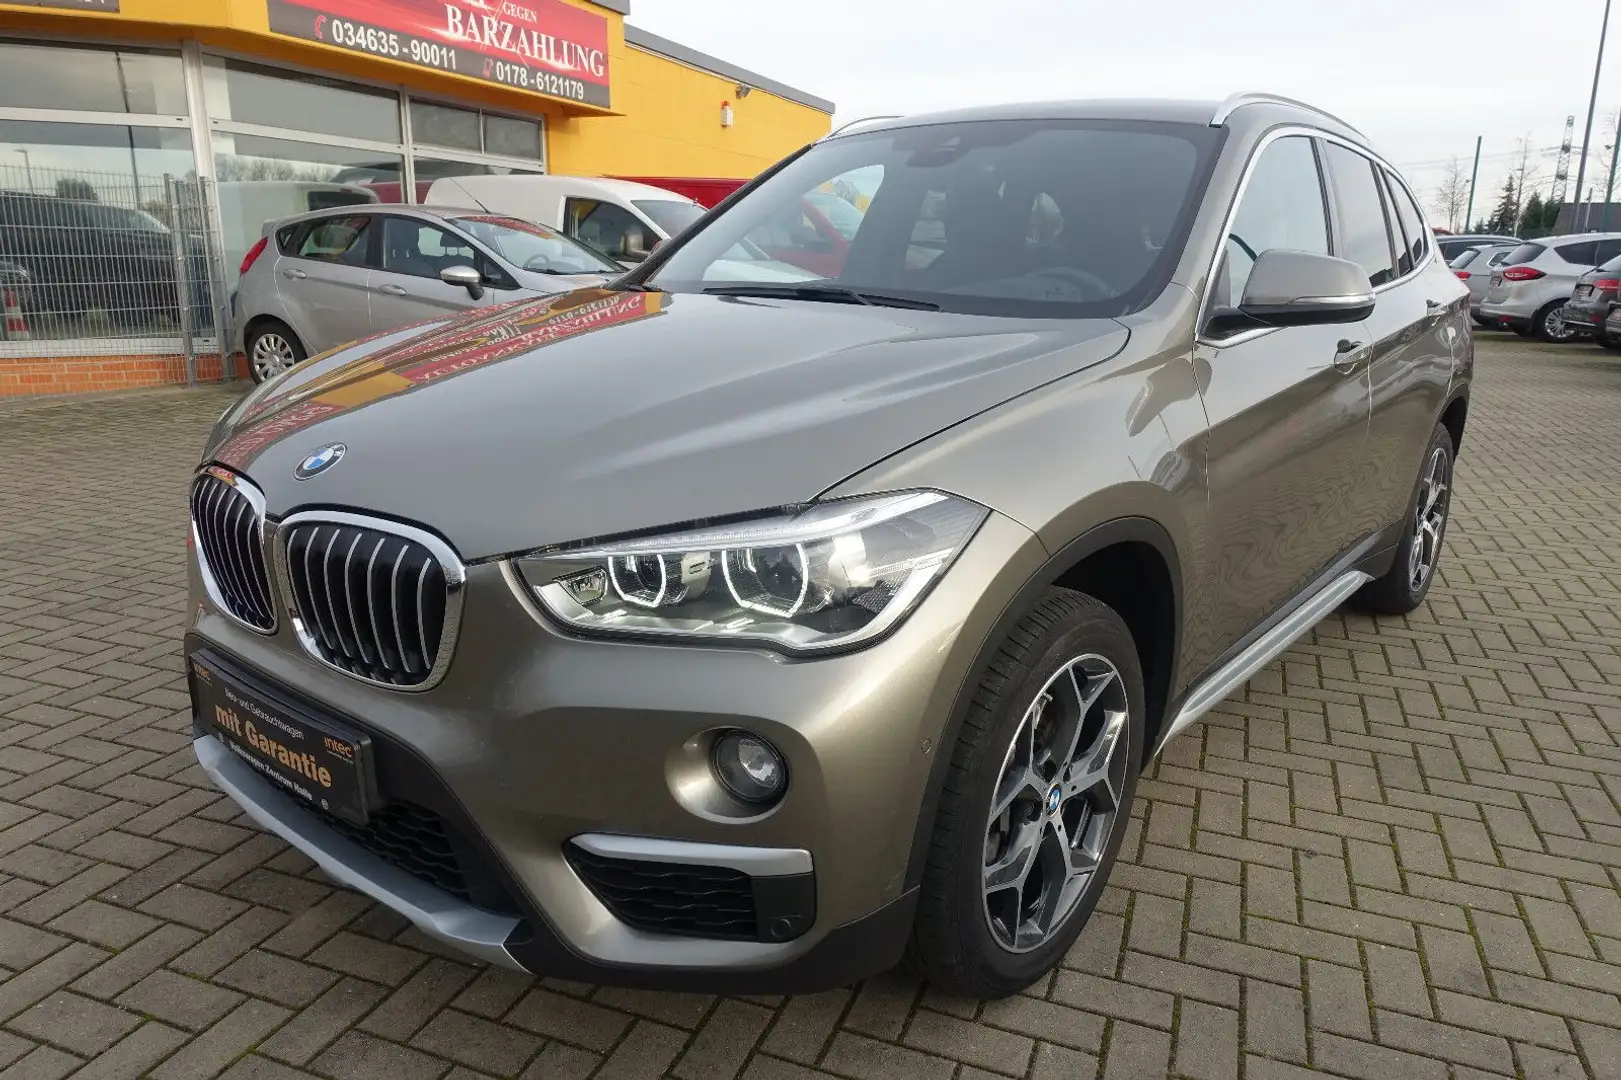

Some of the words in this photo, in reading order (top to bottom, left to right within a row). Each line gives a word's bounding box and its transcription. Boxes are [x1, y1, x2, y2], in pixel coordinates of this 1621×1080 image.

[502, 1, 538, 24] GEGEN
[332, 19, 457, 70] 034635-90011
[445, 3, 605, 77] BARZAHLUNG
[496, 61, 584, 100] 0178-6121179
[214, 704, 243, 737] mit
[245, 720, 332, 788] Garantie
